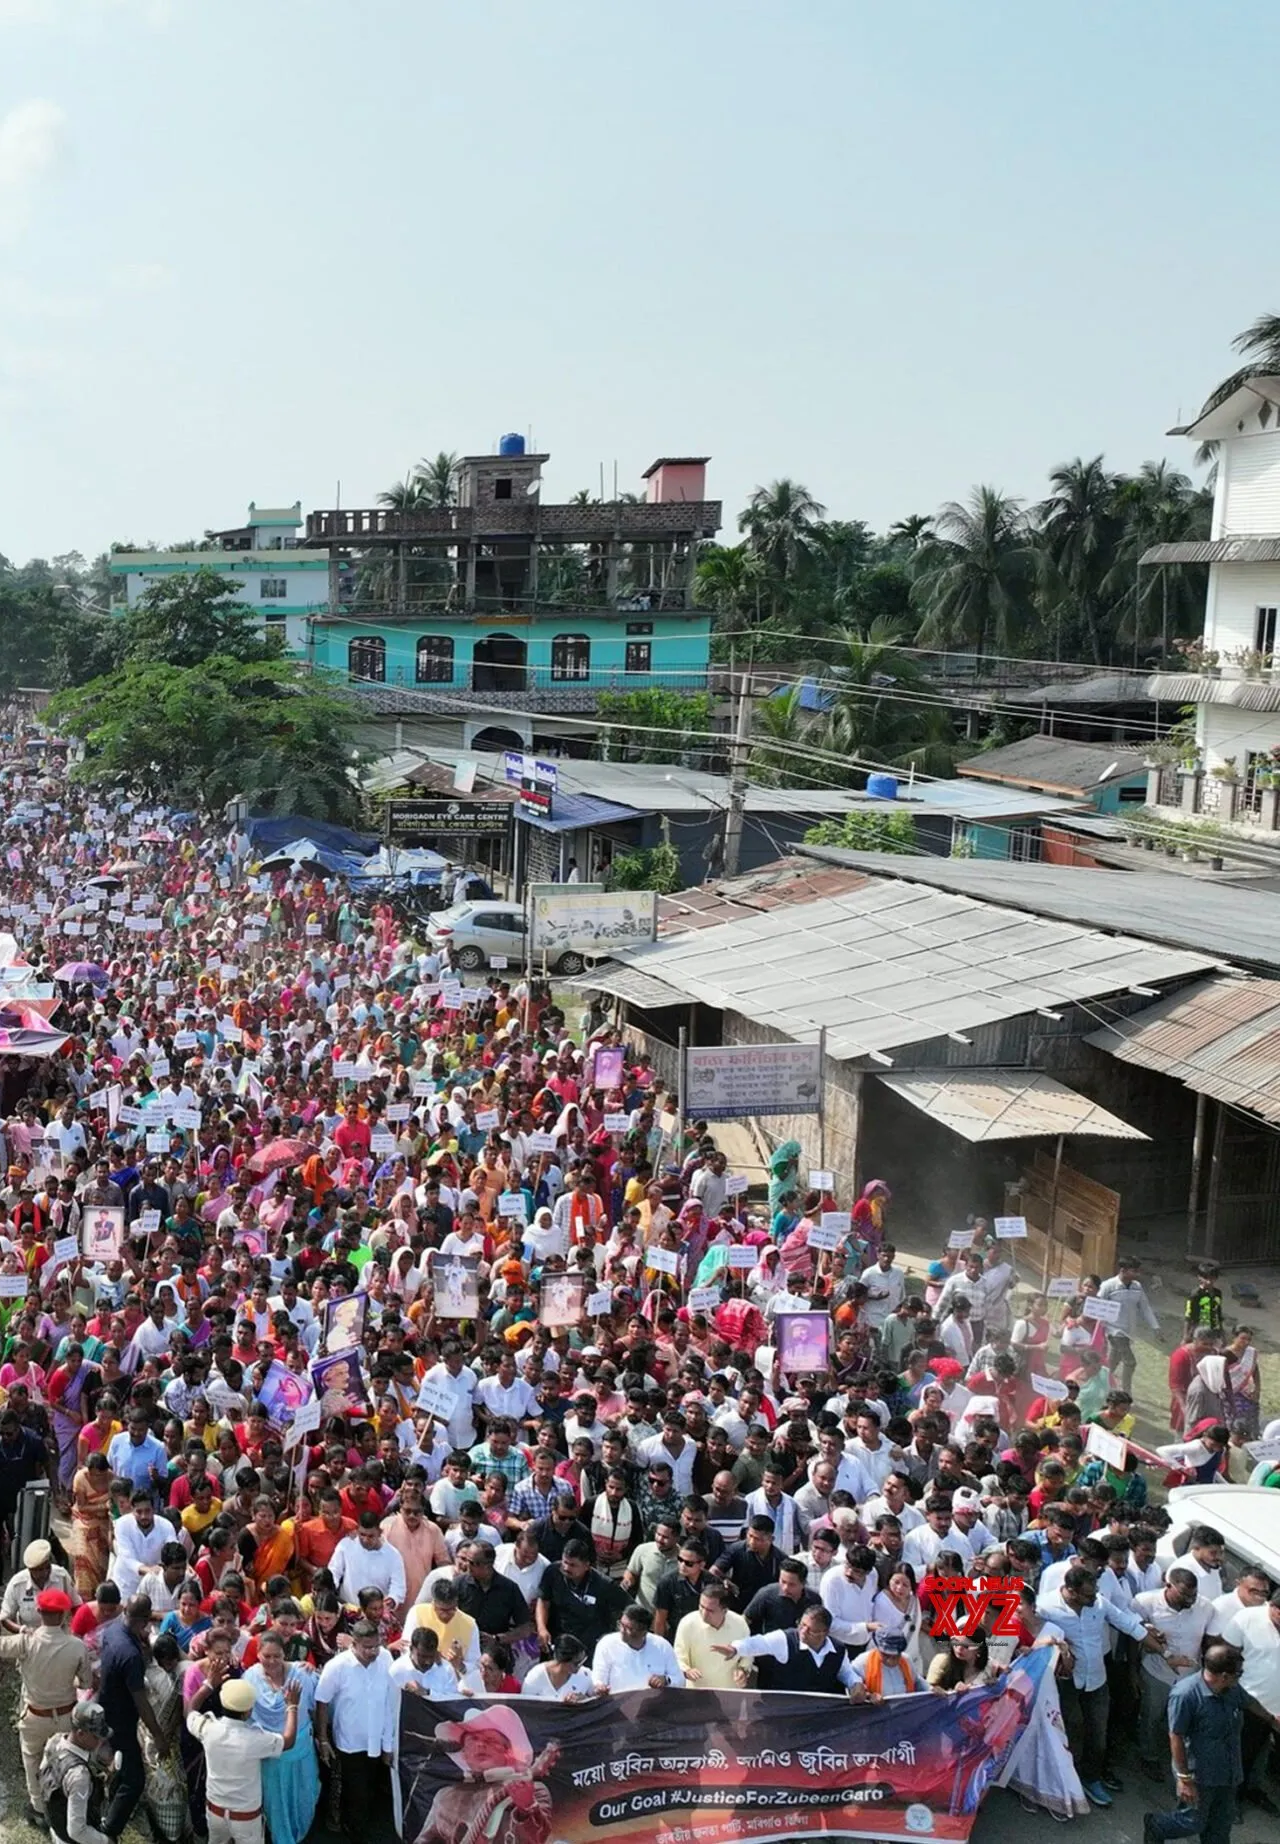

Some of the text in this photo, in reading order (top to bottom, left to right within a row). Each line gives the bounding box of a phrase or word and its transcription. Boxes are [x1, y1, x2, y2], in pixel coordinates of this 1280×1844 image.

[392, 813, 508, 821] MORIGAON EYE CARE CENTRE
[571, 1762, 606, 1787] ময়ো
[609, 1752, 654, 1781] জুবিন
[797, 1745, 849, 1776] জুবিন
[599, 1801, 627, 1819] Our
[631, 1791, 666, 1811] Goal
